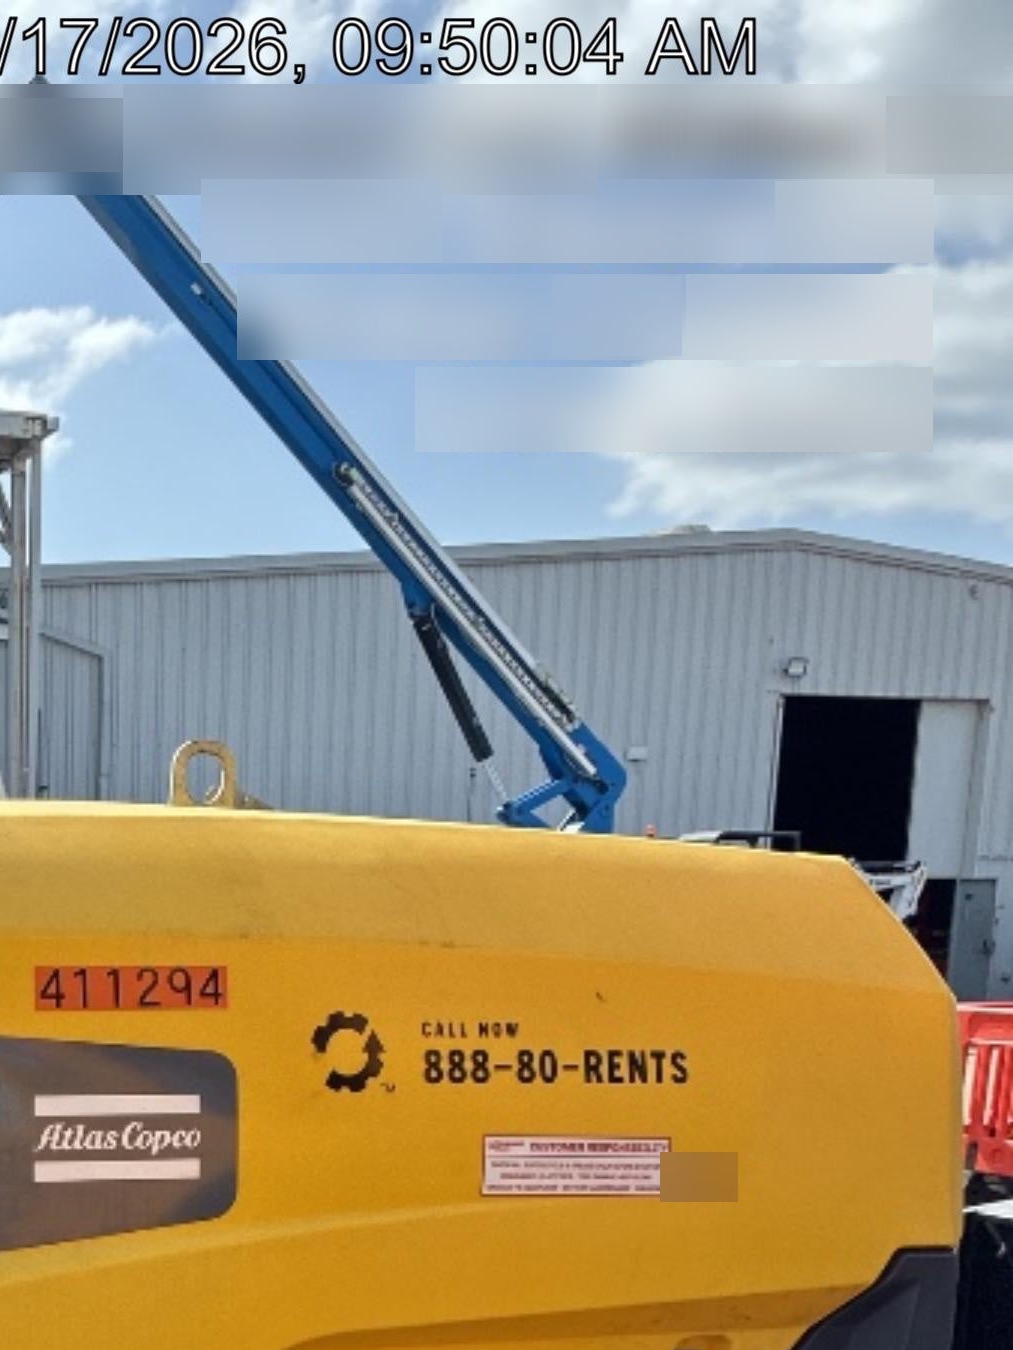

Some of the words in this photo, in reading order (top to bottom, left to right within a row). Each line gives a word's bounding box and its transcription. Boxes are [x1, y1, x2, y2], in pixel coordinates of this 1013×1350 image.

[40, 967, 222, 1009] 411294
[421, 1021, 469, 1039] CALL
[478, 1021, 520, 1039] NOW
[423, 1048, 689, 1084] 888-80-RENTS
[34, 1121, 119, 1152] Atlas
[121, 1121, 202, 1156] Copco
